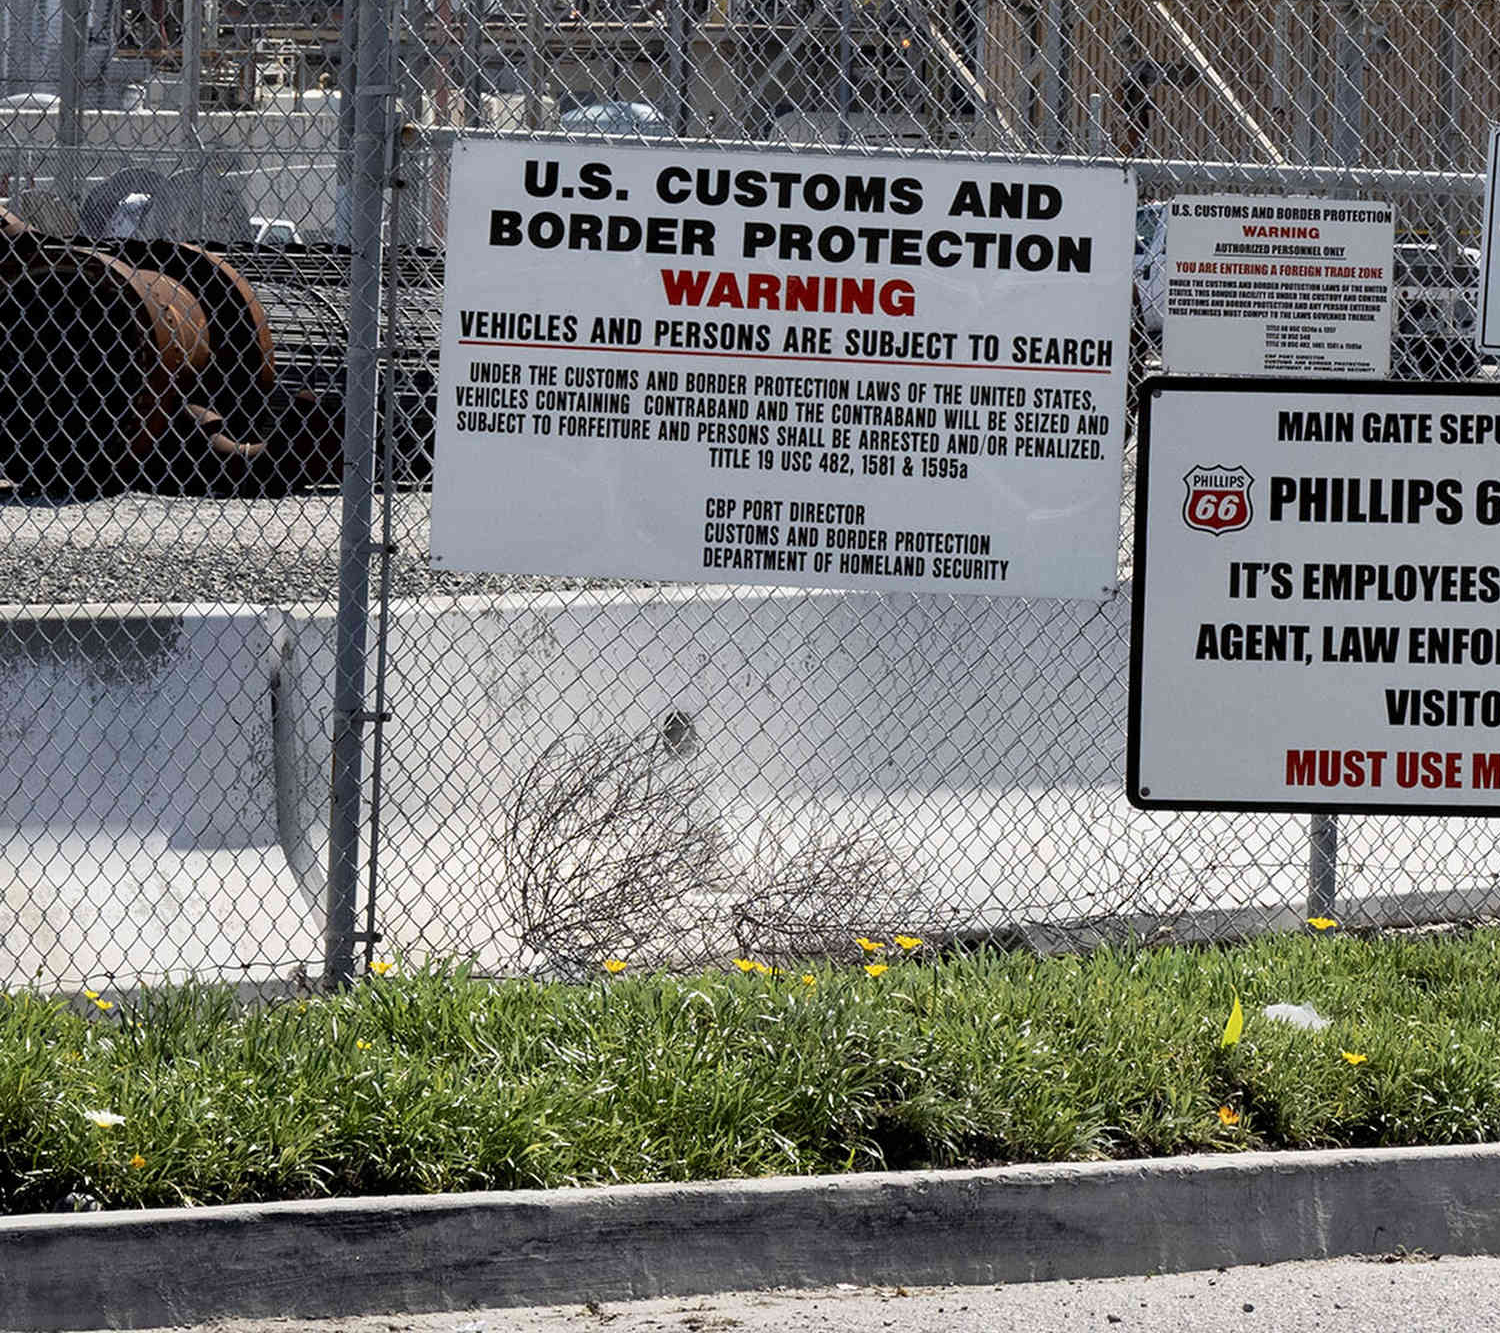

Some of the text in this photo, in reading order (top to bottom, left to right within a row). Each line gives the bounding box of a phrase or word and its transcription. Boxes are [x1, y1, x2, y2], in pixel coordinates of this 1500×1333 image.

[524, 160, 1062, 220] U.S. CUSTOMS AND
[1171, 204, 1391, 223] U.S. CUSTOMS AND BORDER PROTECTION
[489, 210, 1092, 273] BORDER PROTECTION
[1215, 243, 1345, 256] AUTHORIZED PERSONNEL ONLY
[1242, 226, 1319, 239] WARNING
[1176, 261, 1383, 279] YOU ARE ENTERING A FOREIGN TRADE ZONE
[660, 269, 915, 317] WARNING
[460, 310, 1112, 367] VEHICLES AND PERSONS ARE SUBJECT TO SEARCH
[470, 362, 1095, 412] UNDER THE CUSTOMS AND BORDER PROTECTION LAWS OF THE UNITED STATES,
[456, 386, 1108, 435] VEHICLES CONTAINING CONTRABAND AND THE CONTRABAND WILL BE SEIZED AND
[1278, 411, 1354, 442] MAIN
[1362, 412, 1432, 443] GATE
[456, 411, 1104, 460] SUBJECT TO FORFEITURE AND PERSONS SHALL BE ARRESTED AND/OR PENALIZED.
[708, 447, 967, 479] TITLE 19 USC 482, 1581 & 1595a
[1193, 475, 1245, 488] PHILLIPS
[706, 498, 865, 525] CBP PORT DIRECTOR
[1195, 494, 1240, 521] 66
[1269, 477, 1462, 525] PHILLIPS
[704, 522, 990, 555] CUSTOMS AND BORDER PROTECTION
[703, 547, 1008, 581] DEPARTMENT OF HOMELAND SECURITY
[1229, 562, 1292, 599] IT'S
[1302, 564, 1500, 603] EMPLOYEES
[1195, 623, 1312, 666] AGENT,
[1322, 626, 1399, 663] LAW
[1285, 750, 1387, 787] MUST
[1396, 752, 1462, 789] USE
